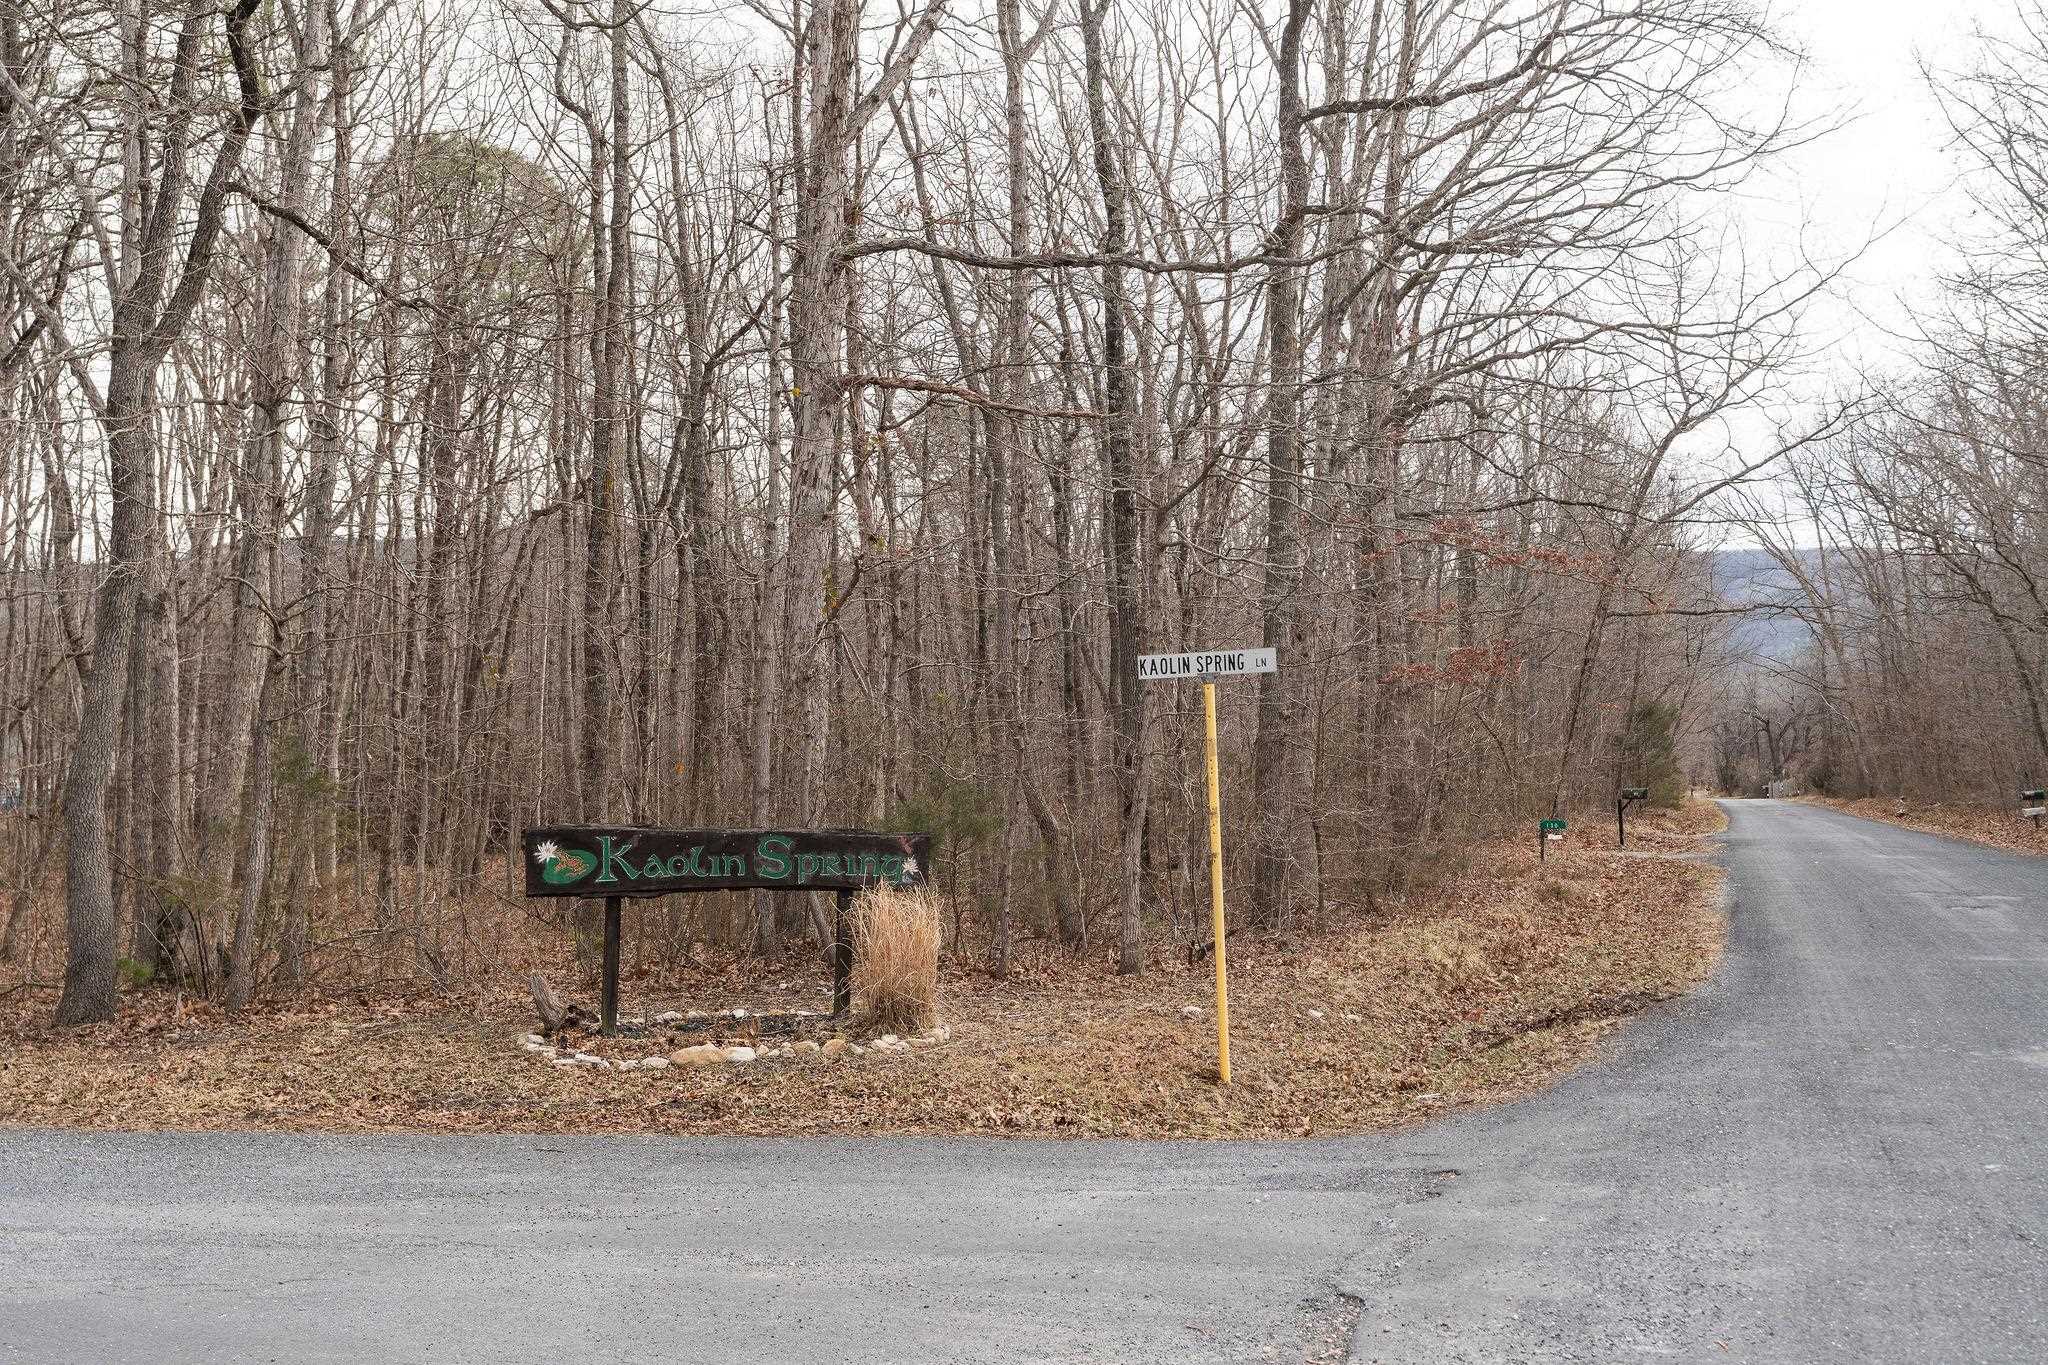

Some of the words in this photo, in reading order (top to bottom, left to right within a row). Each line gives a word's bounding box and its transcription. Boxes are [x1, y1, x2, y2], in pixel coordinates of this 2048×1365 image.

[1139, 656, 1190, 676] KAOLIN
[1196, 653, 1245, 673] SPRING
[1255, 657, 1267, 668] LN
[595, 836, 746, 882] Kaolin
[755, 835, 902, 885] Spring
